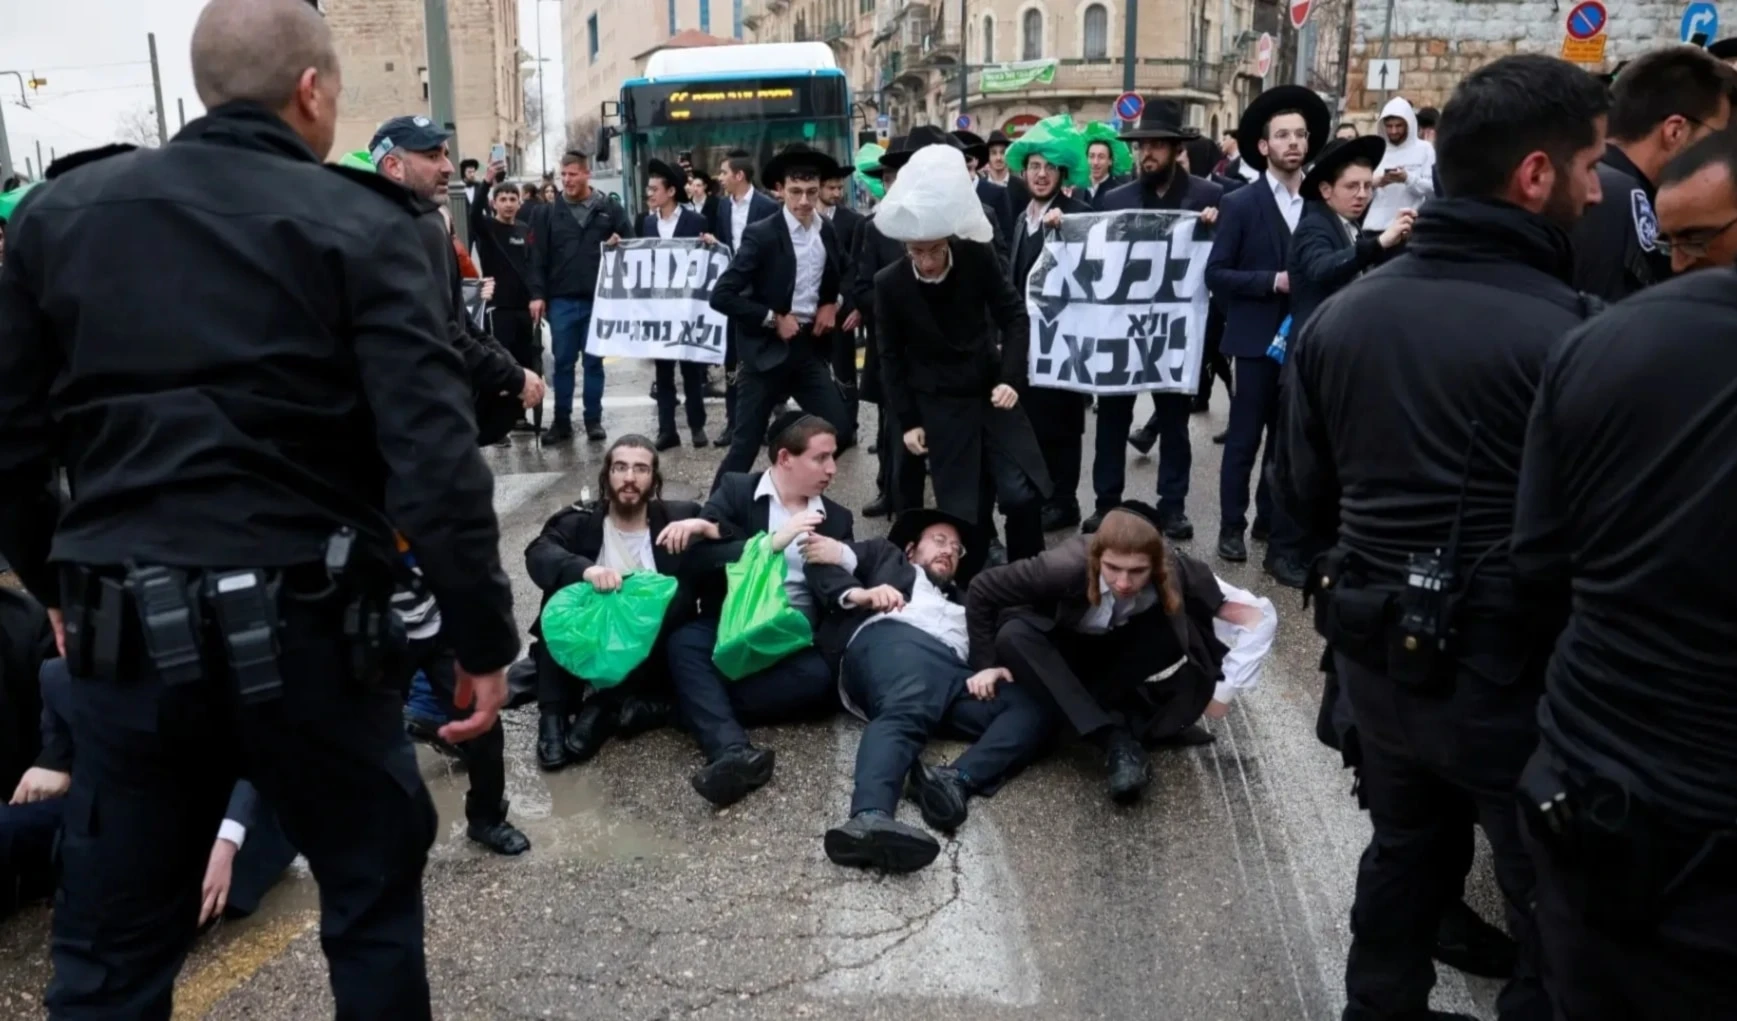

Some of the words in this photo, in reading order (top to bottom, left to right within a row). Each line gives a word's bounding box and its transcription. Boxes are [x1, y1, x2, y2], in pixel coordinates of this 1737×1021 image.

[1042, 218, 1213, 300] לכלא
[677, 314, 722, 346] ולא
[1127, 308, 1169, 337] ולא
